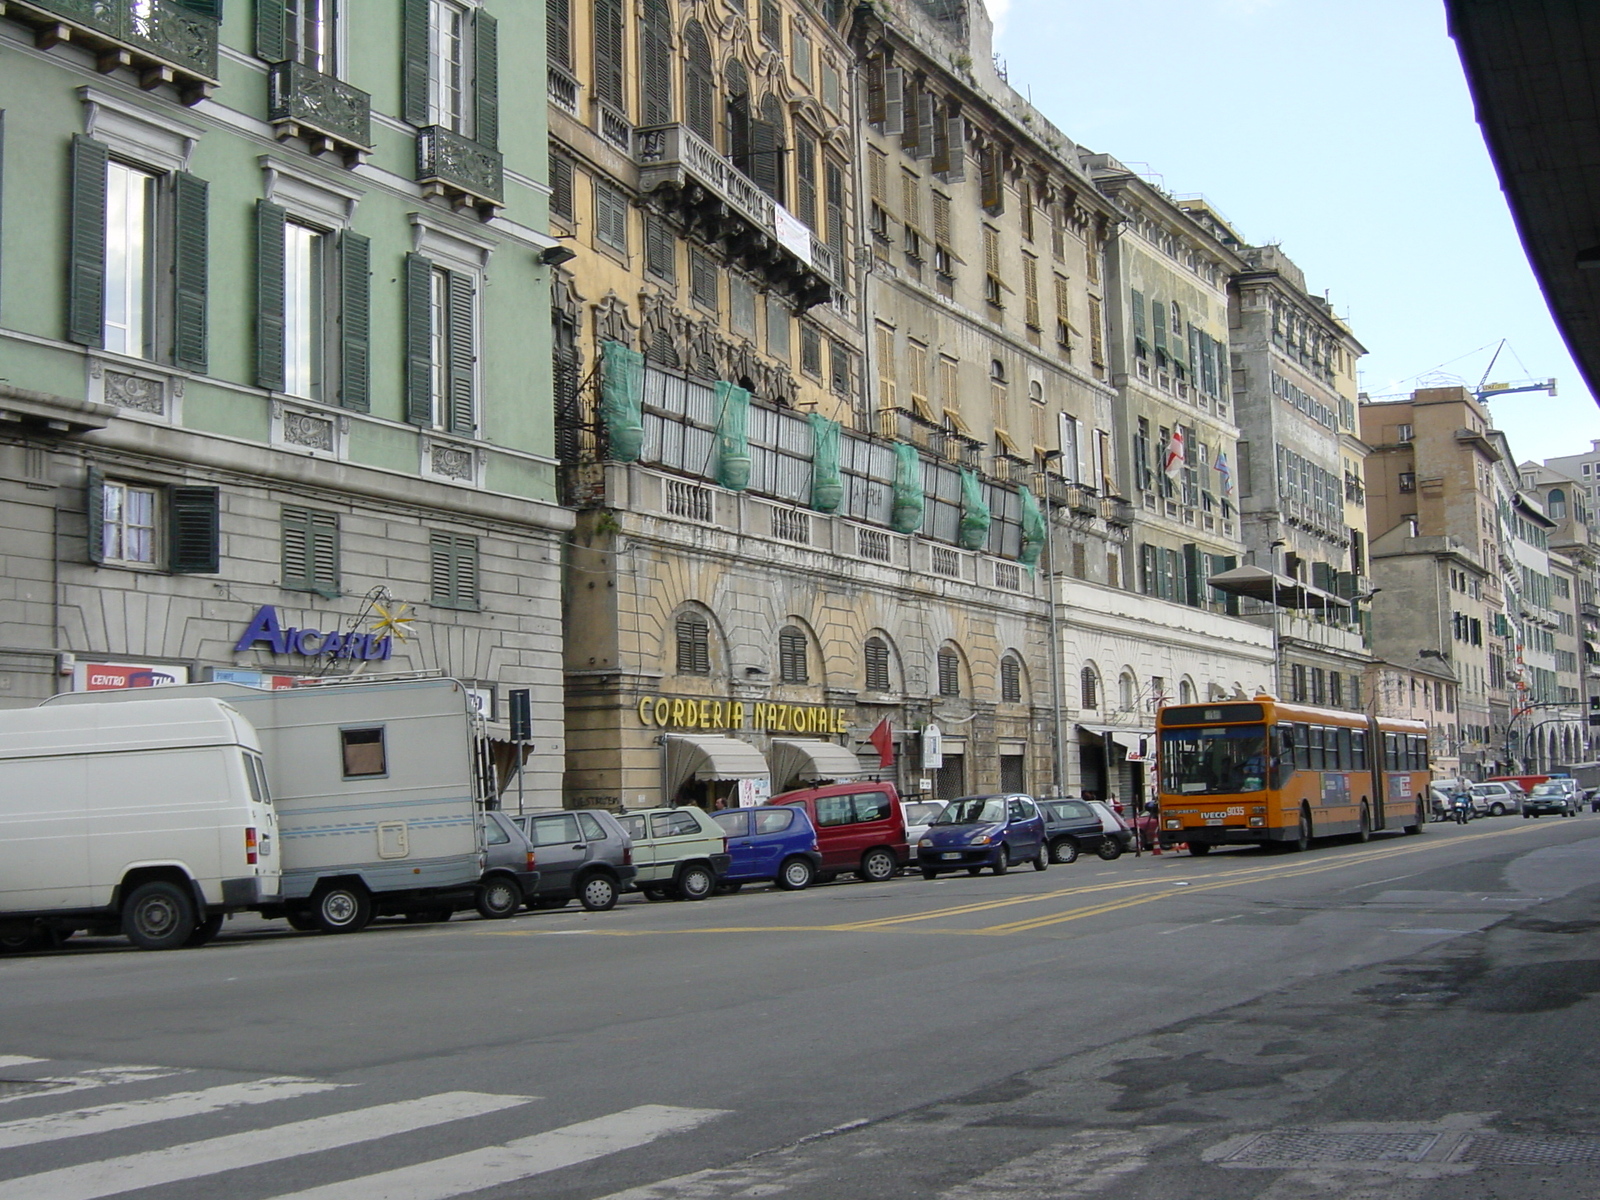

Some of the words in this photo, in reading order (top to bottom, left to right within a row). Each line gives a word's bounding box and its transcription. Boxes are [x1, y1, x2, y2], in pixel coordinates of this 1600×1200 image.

[234, 605, 392, 661] AICARDI
[91, 675, 125, 686] CENTRO
[638, 695, 744, 729] CORDERIA
[755, 702, 848, 733] NAZIONALE
[1201, 811, 1227, 819] IVECO
[1227, 807, 1244, 816] 9035
